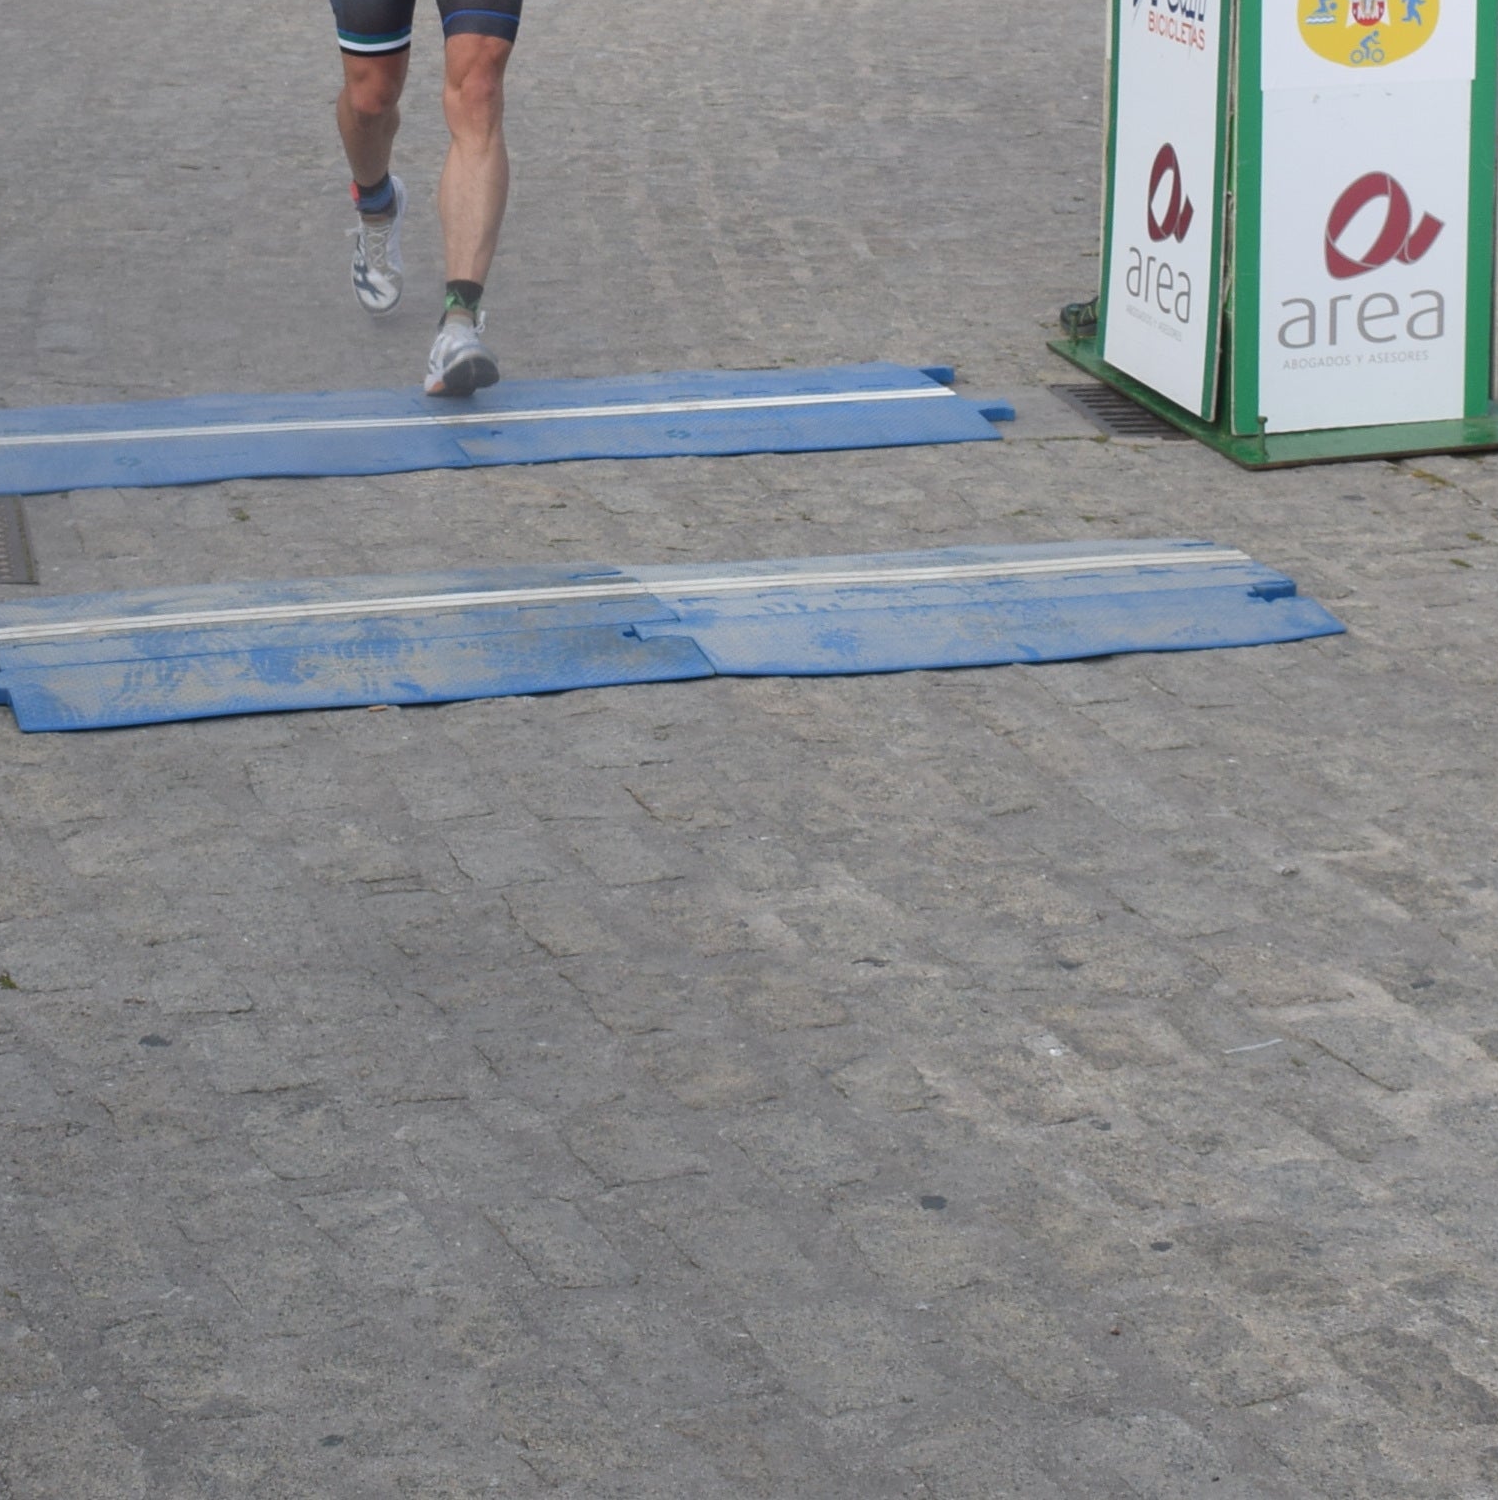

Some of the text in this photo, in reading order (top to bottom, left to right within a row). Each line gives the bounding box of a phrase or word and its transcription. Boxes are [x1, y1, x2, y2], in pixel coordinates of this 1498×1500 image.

[1148, 11, 1206, 51] BICICLETAS
[1126, 246, 1191, 324] area
[1278, 289, 1445, 350] area
[1282, 349, 1429, 371] ABOGADOS Y ASESORES
